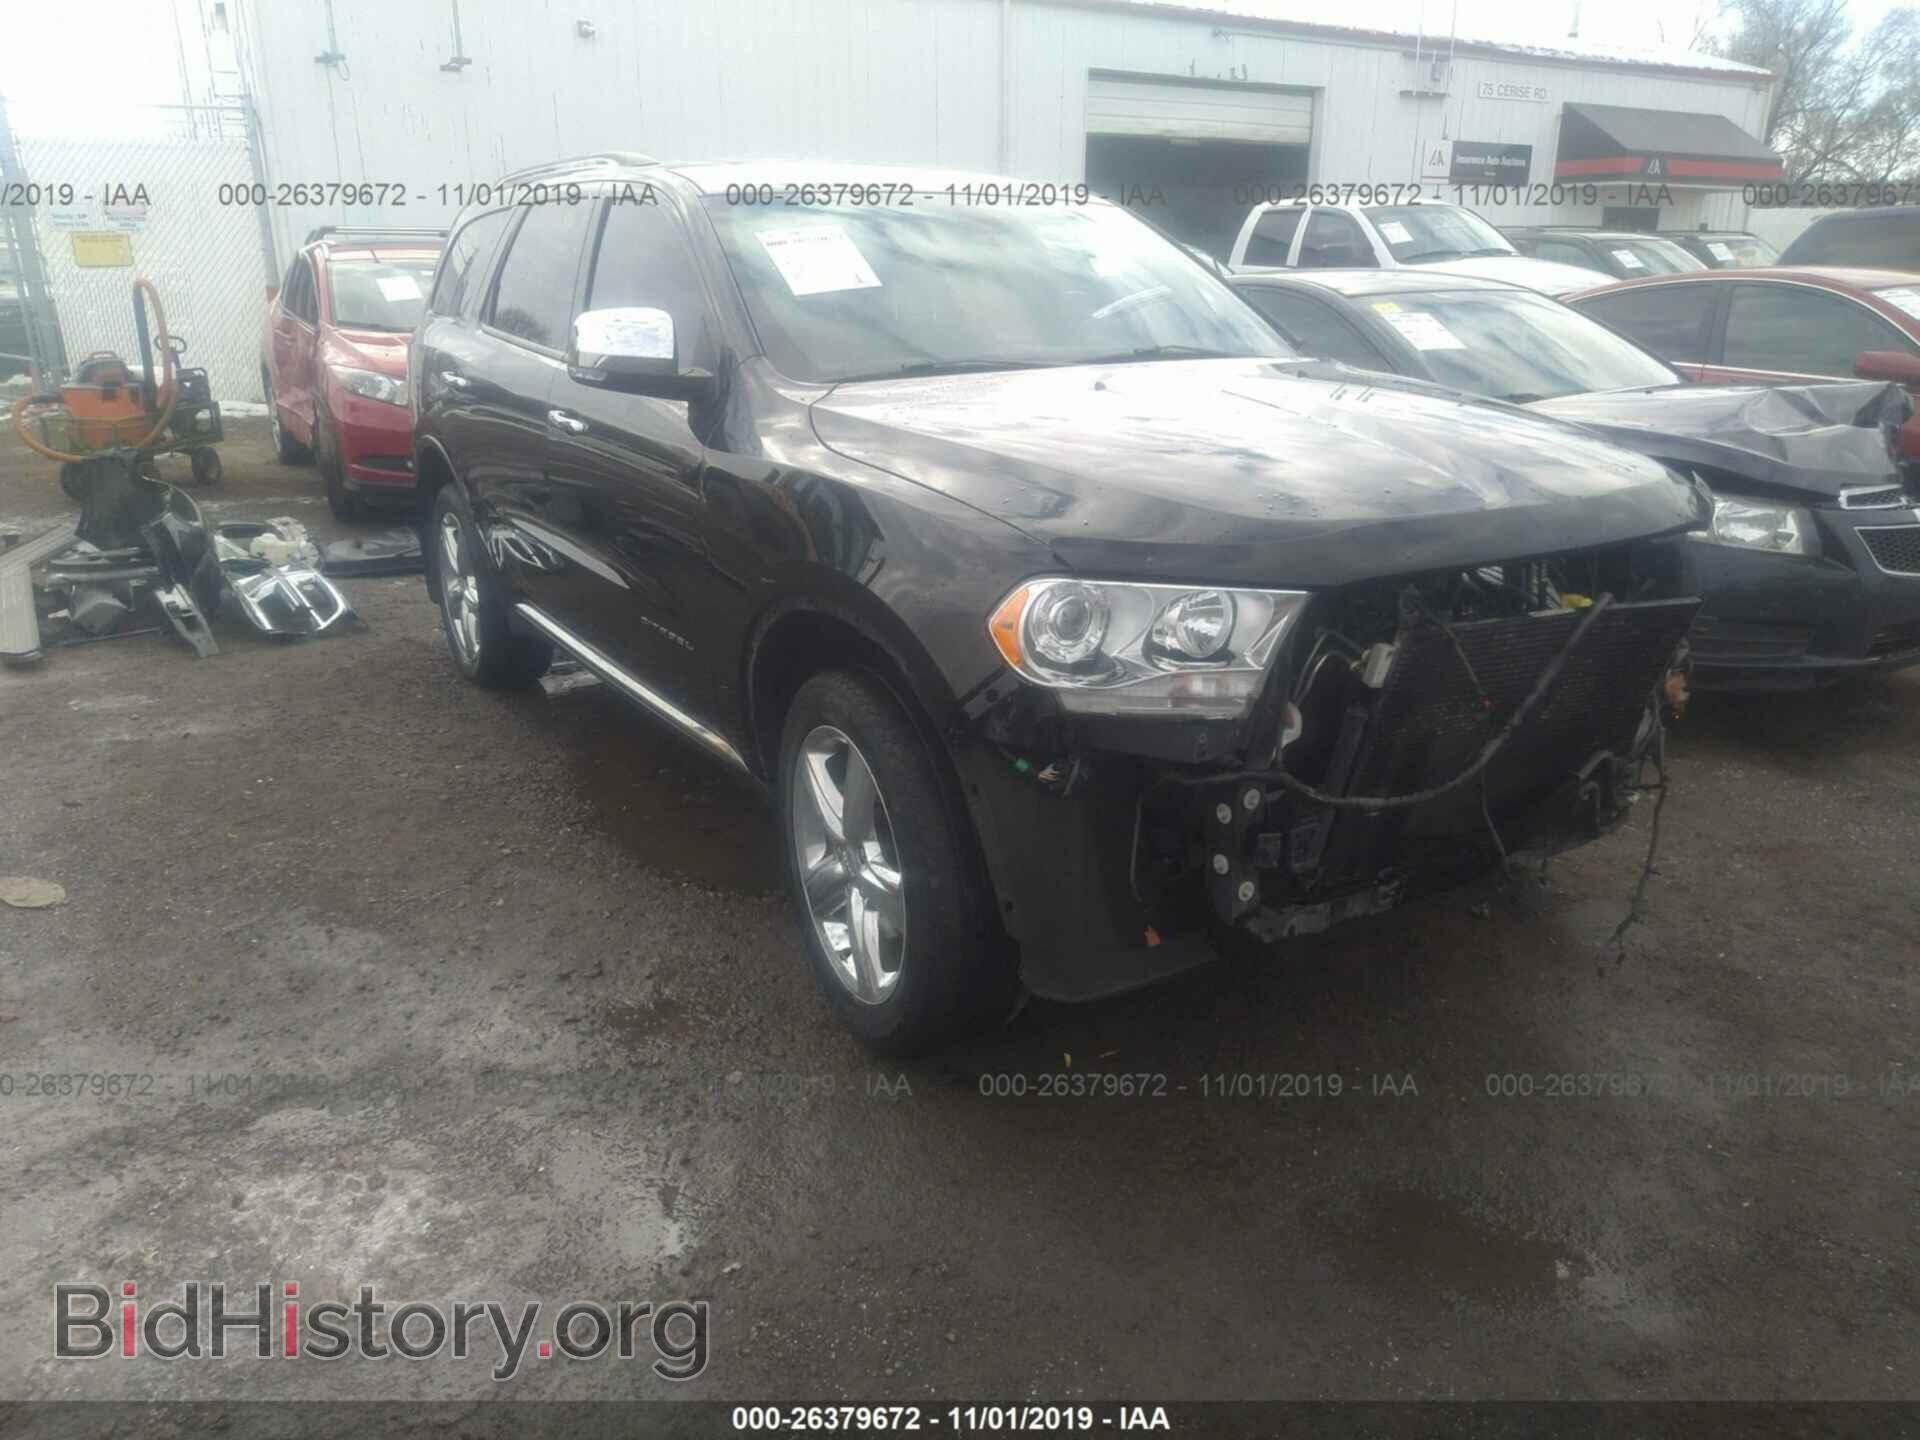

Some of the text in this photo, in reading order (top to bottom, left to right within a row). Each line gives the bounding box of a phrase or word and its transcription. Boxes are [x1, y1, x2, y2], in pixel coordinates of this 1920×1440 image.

[1482, 83, 1546, 98] 75 CERISE RD
